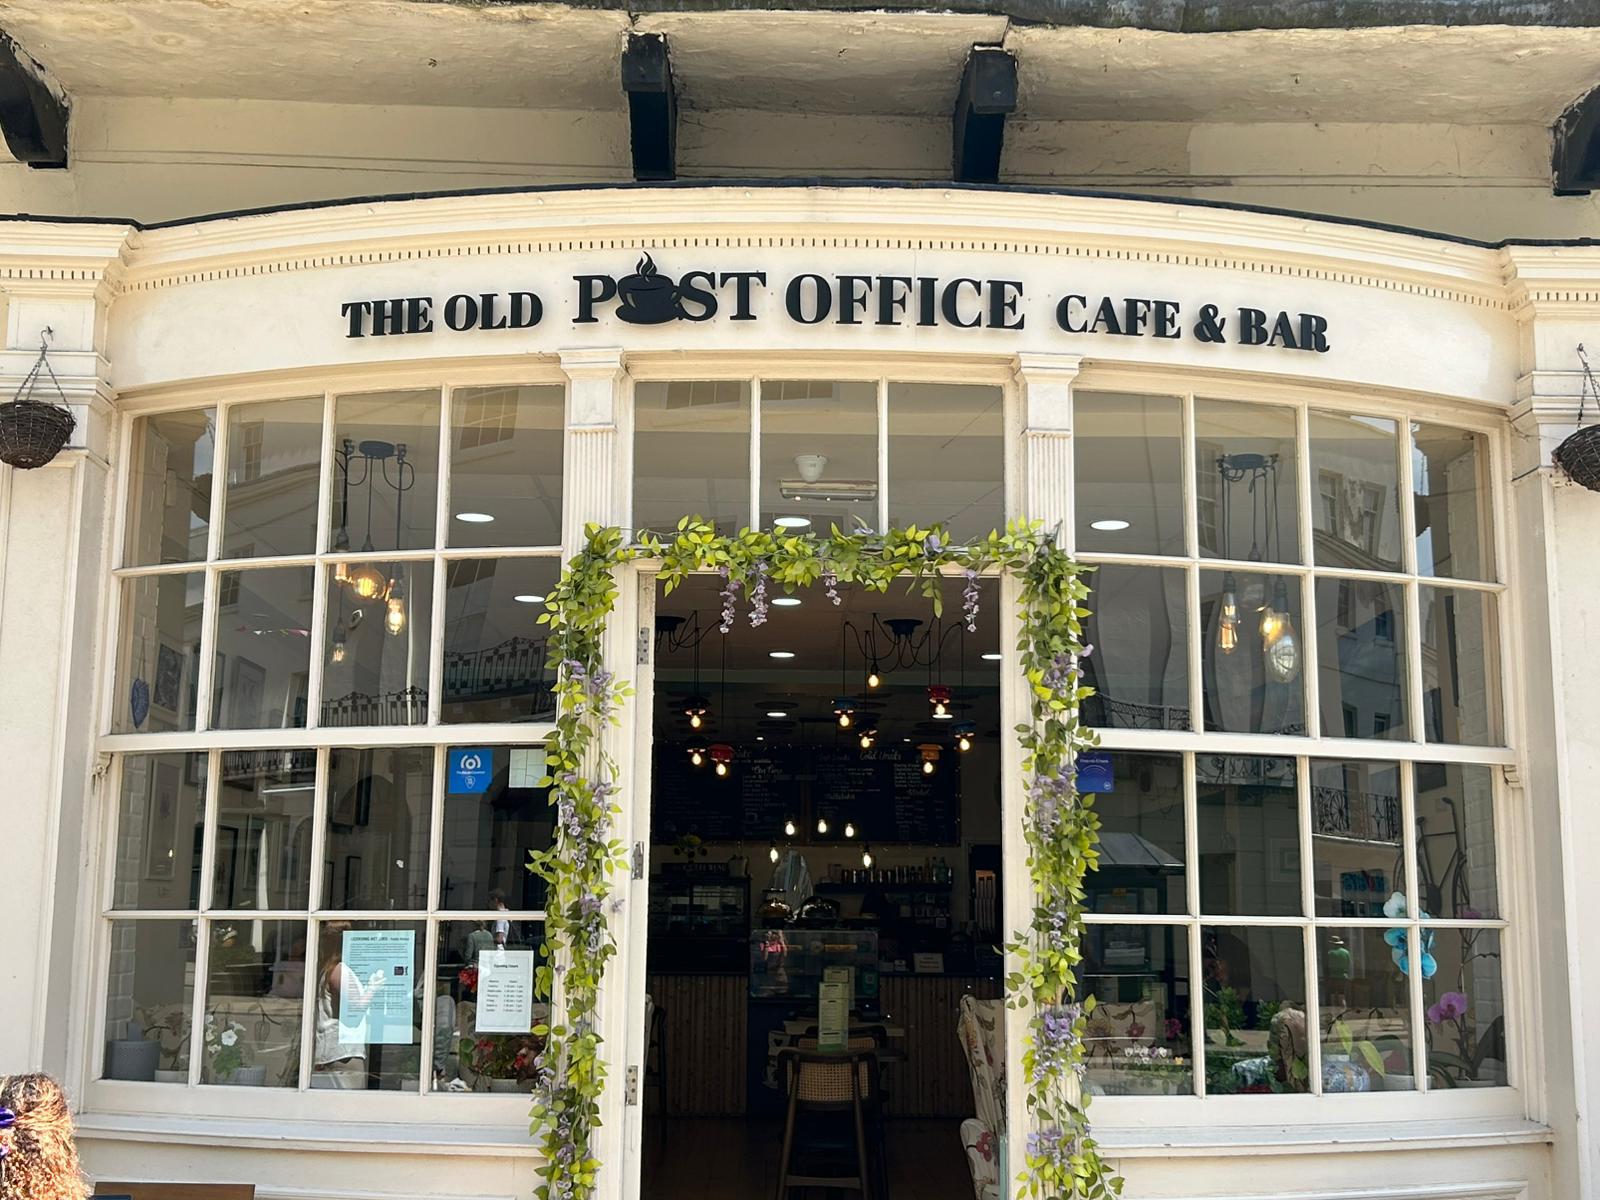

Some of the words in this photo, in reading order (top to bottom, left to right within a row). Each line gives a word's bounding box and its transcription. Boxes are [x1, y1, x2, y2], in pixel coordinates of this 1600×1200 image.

[341, 297, 434, 339] THE
[443, 291, 544, 332] OLD
[785, 273, 1025, 330] OFFICE
[1056, 294, 1182, 339] CAFE
[1193, 303, 1227, 344] &
[1237, 307, 1331, 353] BAR
